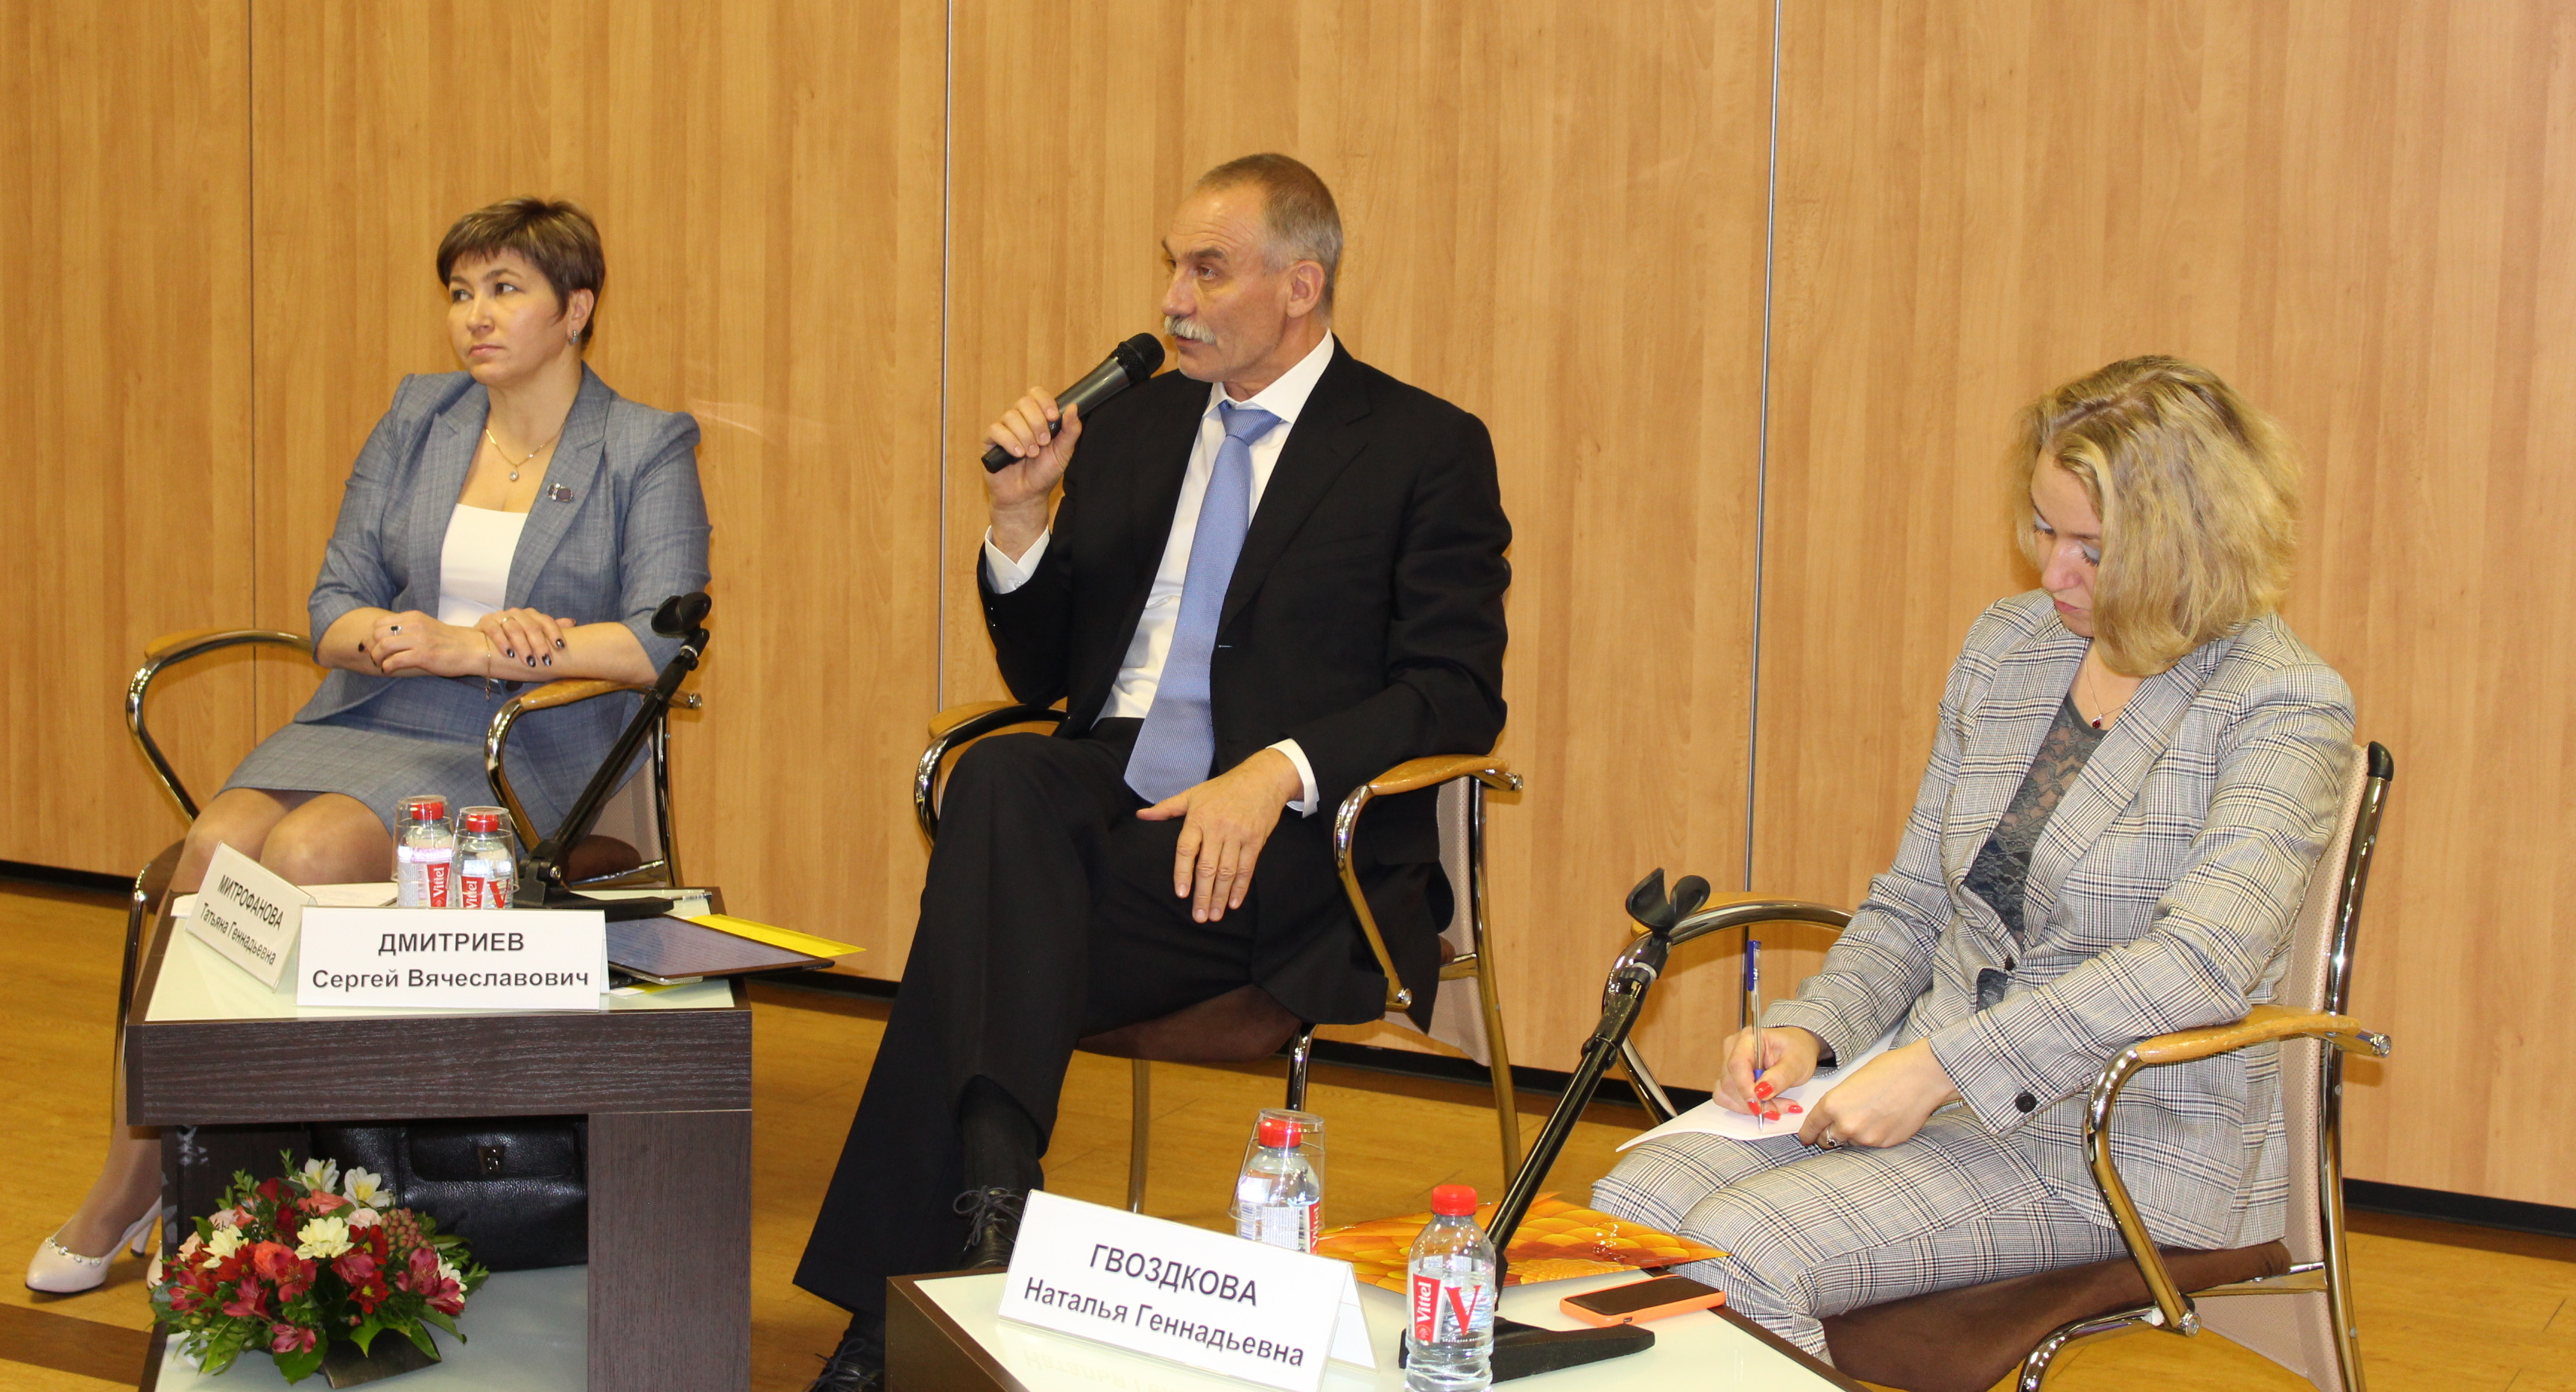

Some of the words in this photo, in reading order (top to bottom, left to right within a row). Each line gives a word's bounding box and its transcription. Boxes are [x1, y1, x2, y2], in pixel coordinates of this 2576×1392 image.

[218, 874, 284, 930] МИТРОФАНОВА
[433, 867, 445, 897] Vittel
[466, 880, 478, 908] Vittel
[200, 902, 229, 934] Татьяна
[227, 921, 277, 966] Геннадьевна
[378, 932, 524, 955] ДМИТРИЕВ
[312, 968, 400, 992] Сергей
[408, 969, 589, 988] Вячеславович
[1090, 1244, 1257, 1306] ГВОЗДКОВА
[1023, 1276, 1128, 1323] Наталья
[1134, 1303, 1304, 1367] Геннадьевна
[1417, 1281, 1432, 1323] Vittel
[1444, 1285, 1482, 1336] V
